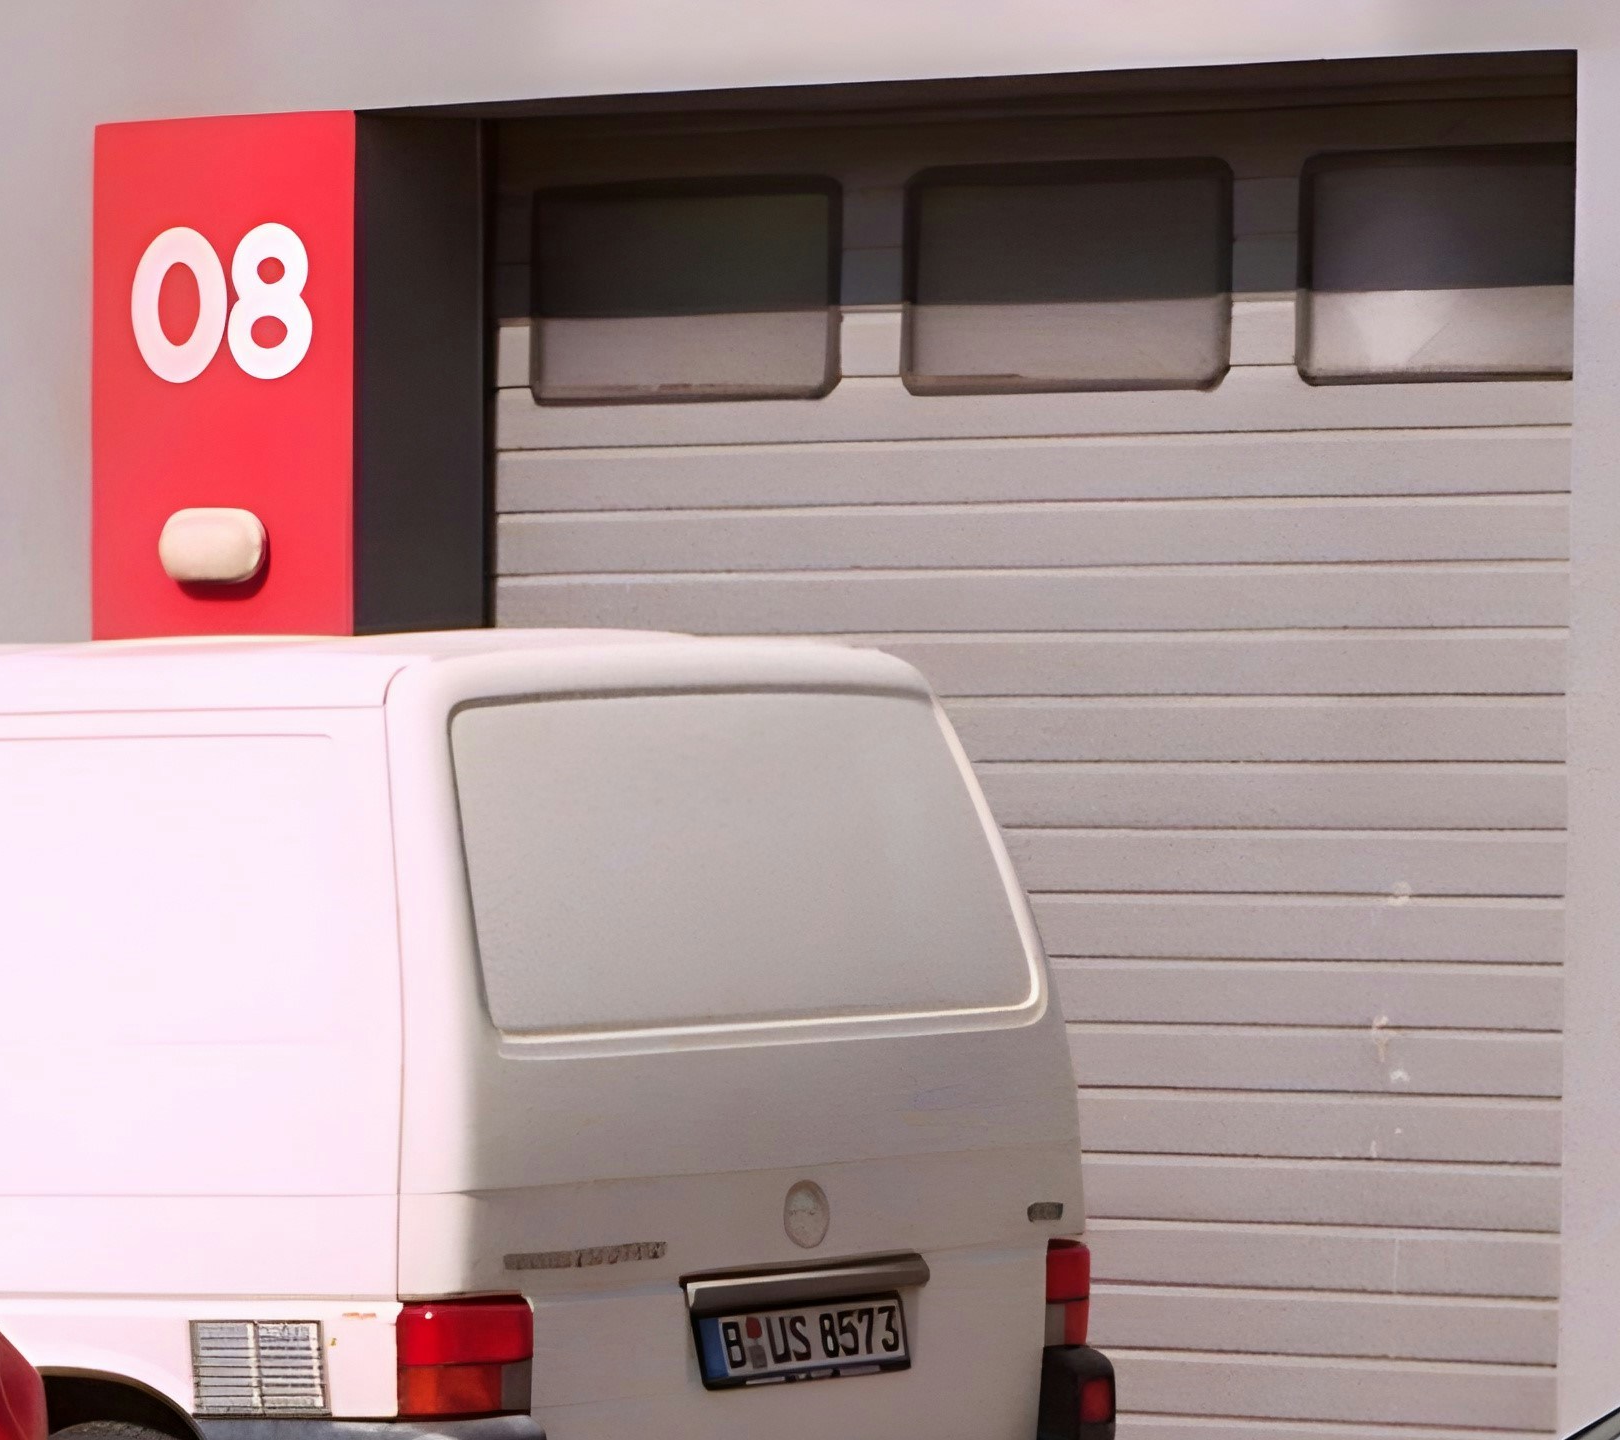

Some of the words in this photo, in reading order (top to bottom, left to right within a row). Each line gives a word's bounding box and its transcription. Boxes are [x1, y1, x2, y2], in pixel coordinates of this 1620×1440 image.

[131, 222, 312, 383] 08
[722, 1321, 746, 1368] B
[765, 1316, 811, 1364] US
[820, 1306, 899, 1358] 8573
